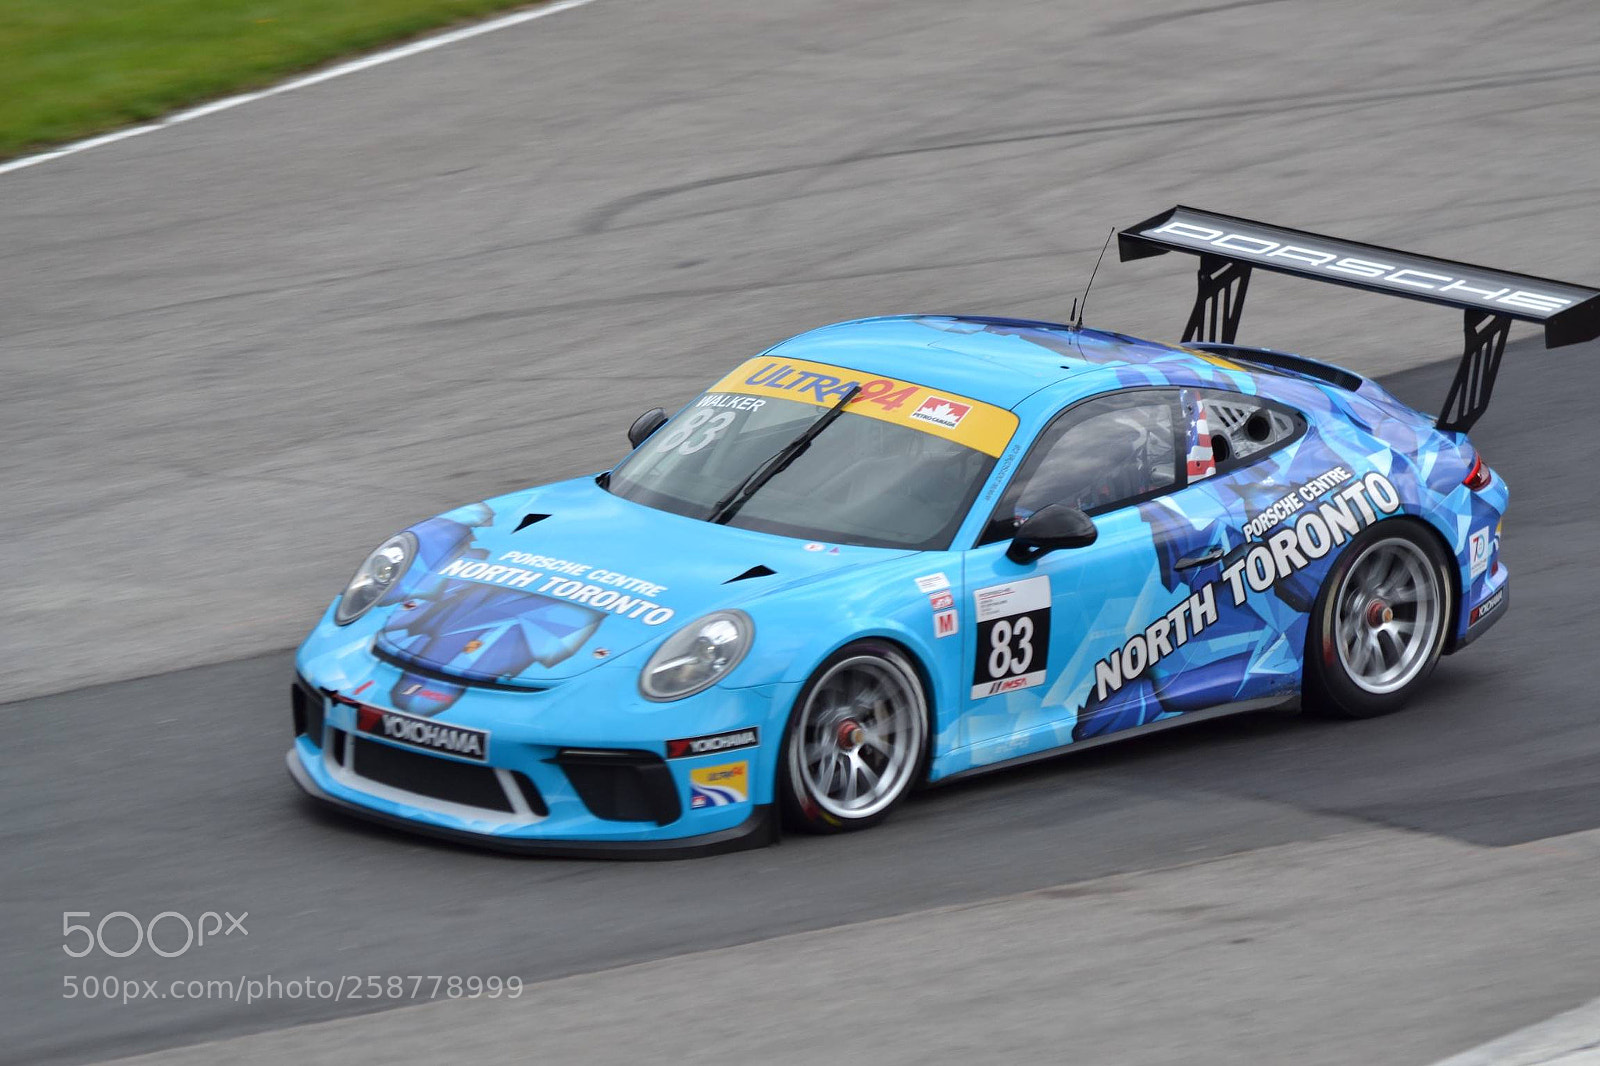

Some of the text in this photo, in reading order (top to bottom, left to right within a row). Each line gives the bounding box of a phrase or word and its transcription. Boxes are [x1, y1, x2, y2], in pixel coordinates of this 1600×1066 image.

[1157, 221, 1572, 312] PORSCHE
[695, 395, 767, 412] WALKER
[656, 408, 736, 456] 83
[1242, 466, 1351, 543] PORSCHE CENTRE
[438, 559, 675, 626] NORTH TORONTO
[499, 550, 668, 597] PORSCHE CENTRE
[1095, 472, 1400, 701] NORTH TORONTO
[988, 616, 1034, 679] 83
[382, 714, 482, 756] YOKOHAMA
[689, 731, 756, 753] YOKOHAMA
